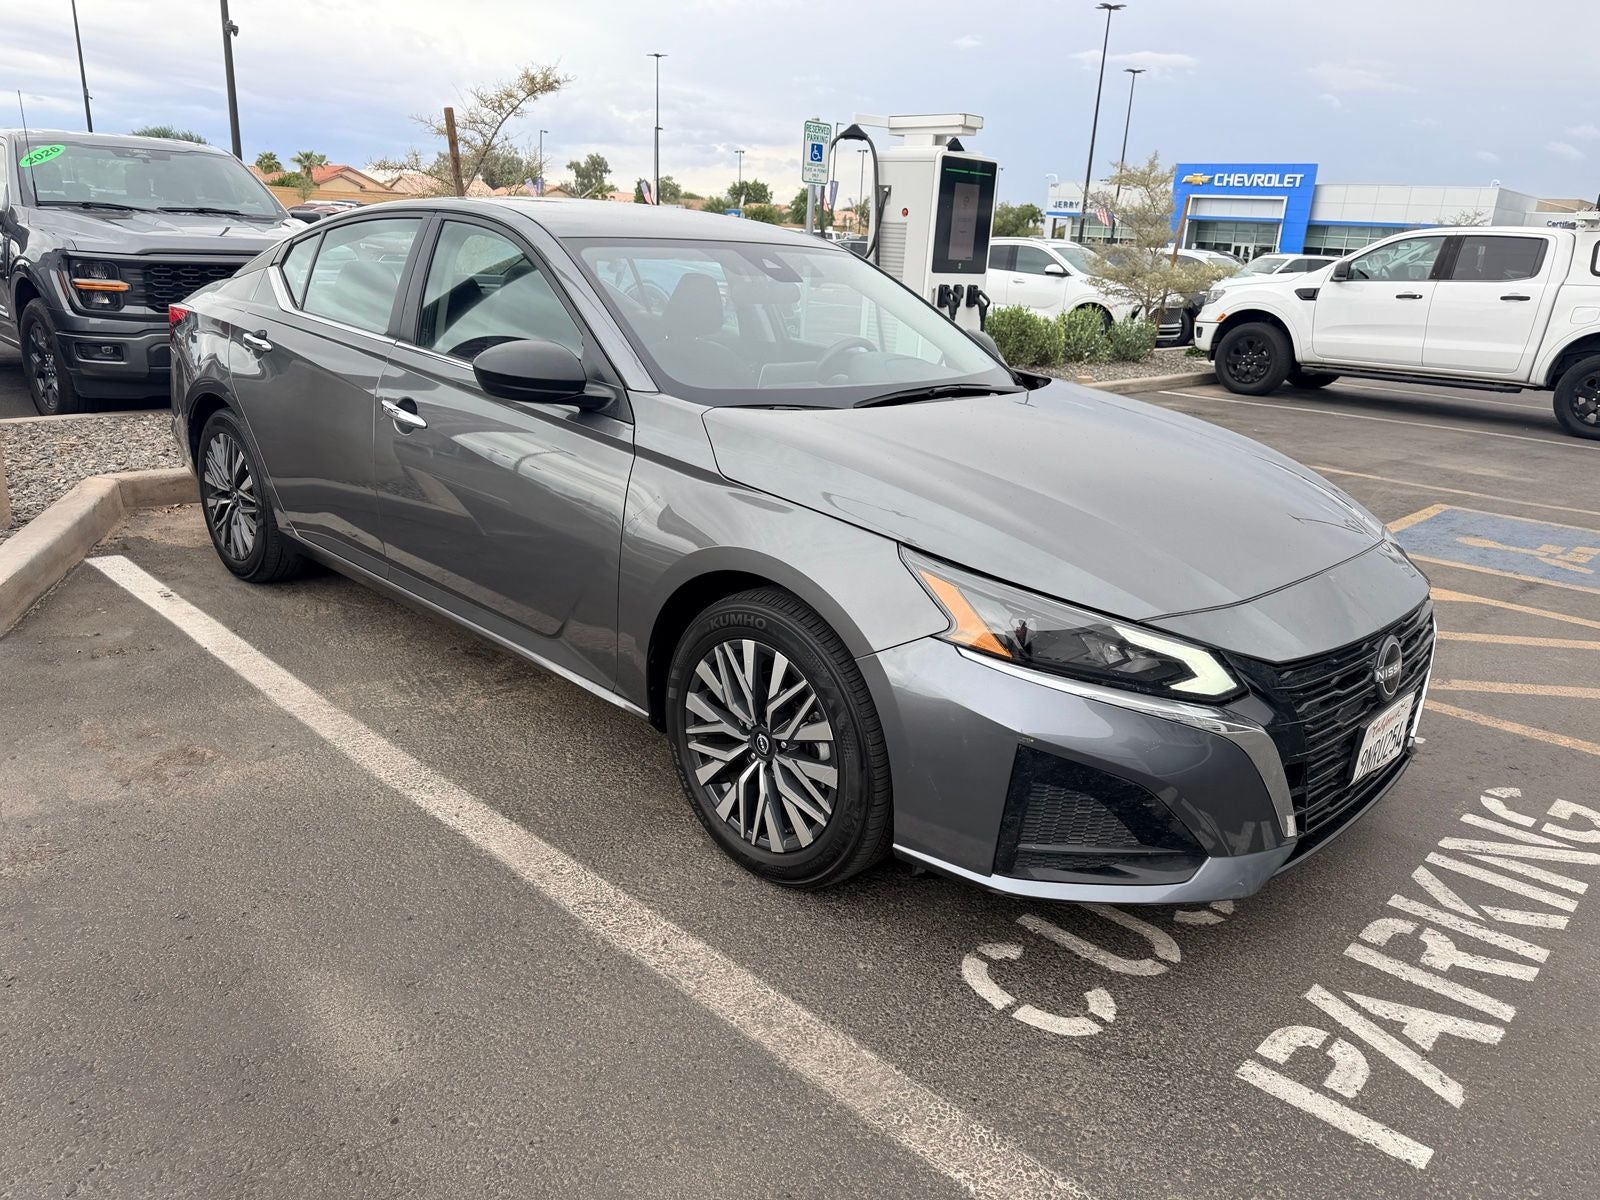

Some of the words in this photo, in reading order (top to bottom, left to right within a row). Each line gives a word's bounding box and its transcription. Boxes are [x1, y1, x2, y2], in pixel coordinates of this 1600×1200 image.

[806, 123, 830, 136] RESERVED
[806, 133, 829, 145] PARKING
[26, 146, 60, 164] 2026
[1213, 173, 1304, 187] CHEVROLET
[1053, 201, 1080, 209] JERRY
[710, 612, 767, 630] KUMHO
[1235, 786, 1600, 1170] PARKING
